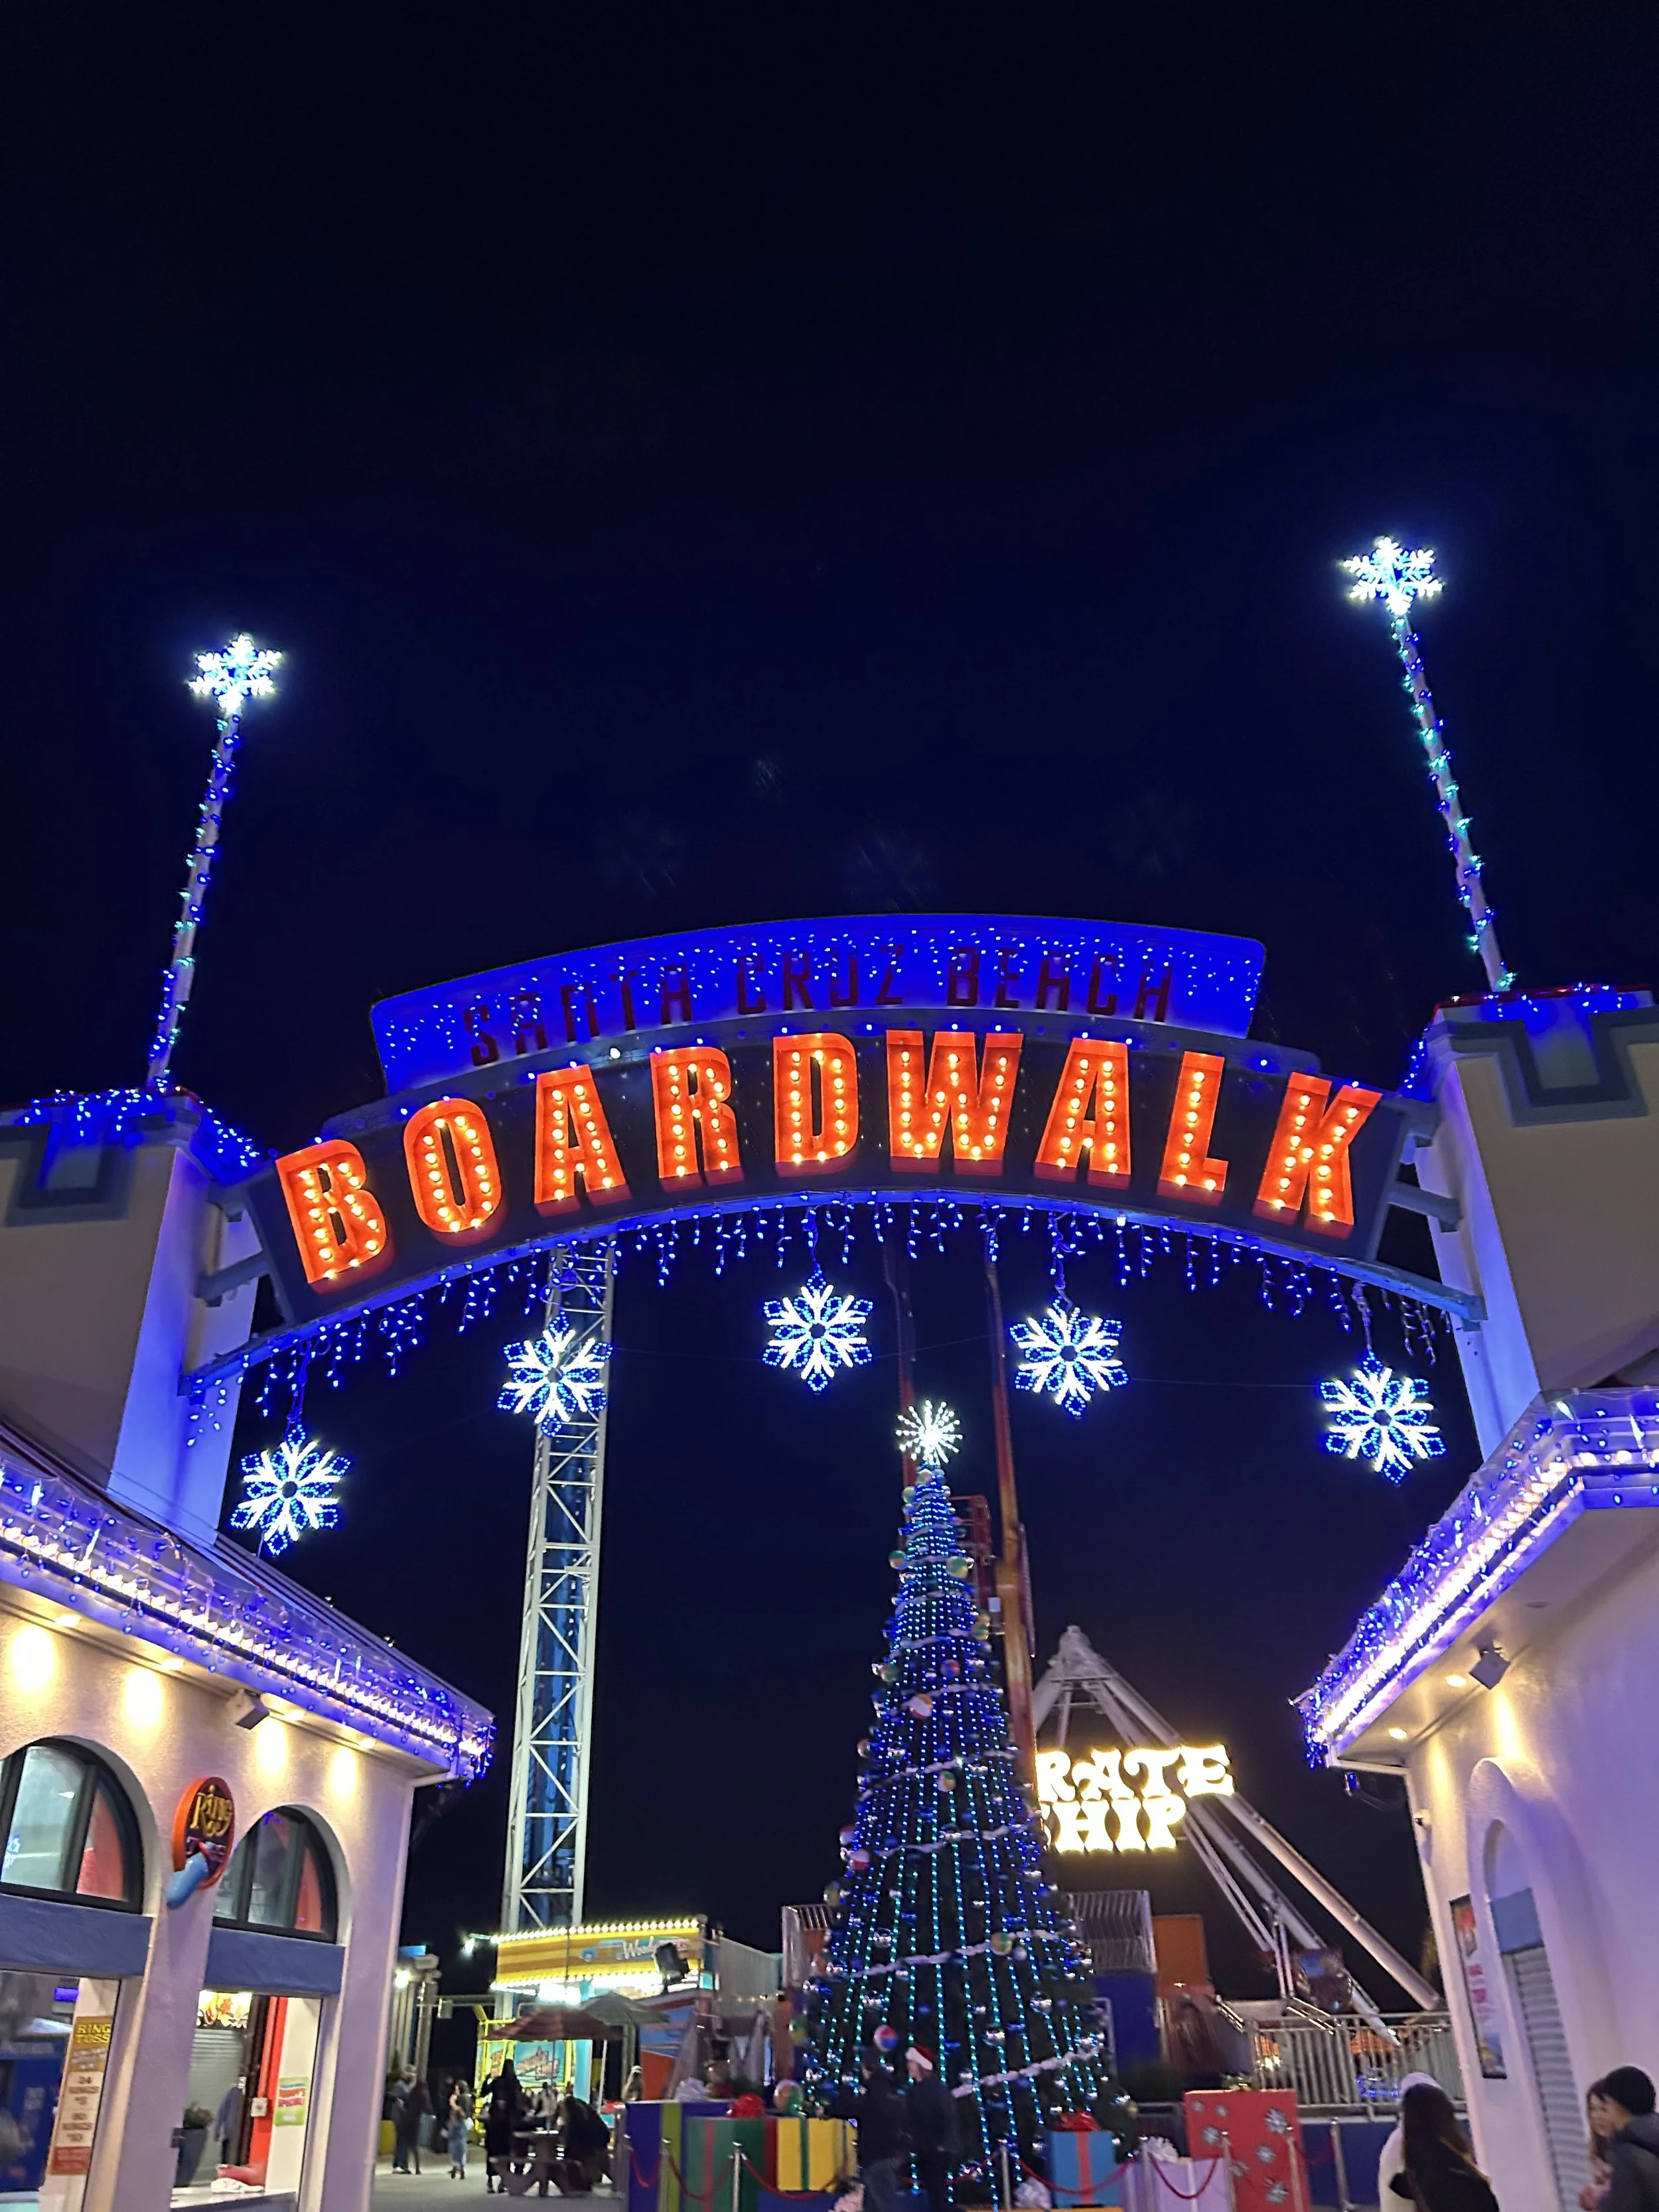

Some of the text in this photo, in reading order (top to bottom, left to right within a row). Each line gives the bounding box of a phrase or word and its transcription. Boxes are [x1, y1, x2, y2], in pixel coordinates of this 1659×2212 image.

[464, 945, 1173, 1067] SANTA CRUZ BEACH
[275, 1029, 1382, 1291] BOARDWALK
[1037, 1743, 1235, 1803] RATE
[1041, 1794, 1187, 1852] HIP
[75, 2033, 111, 2043] TOSS
[77, 2024, 111, 2033] RING
